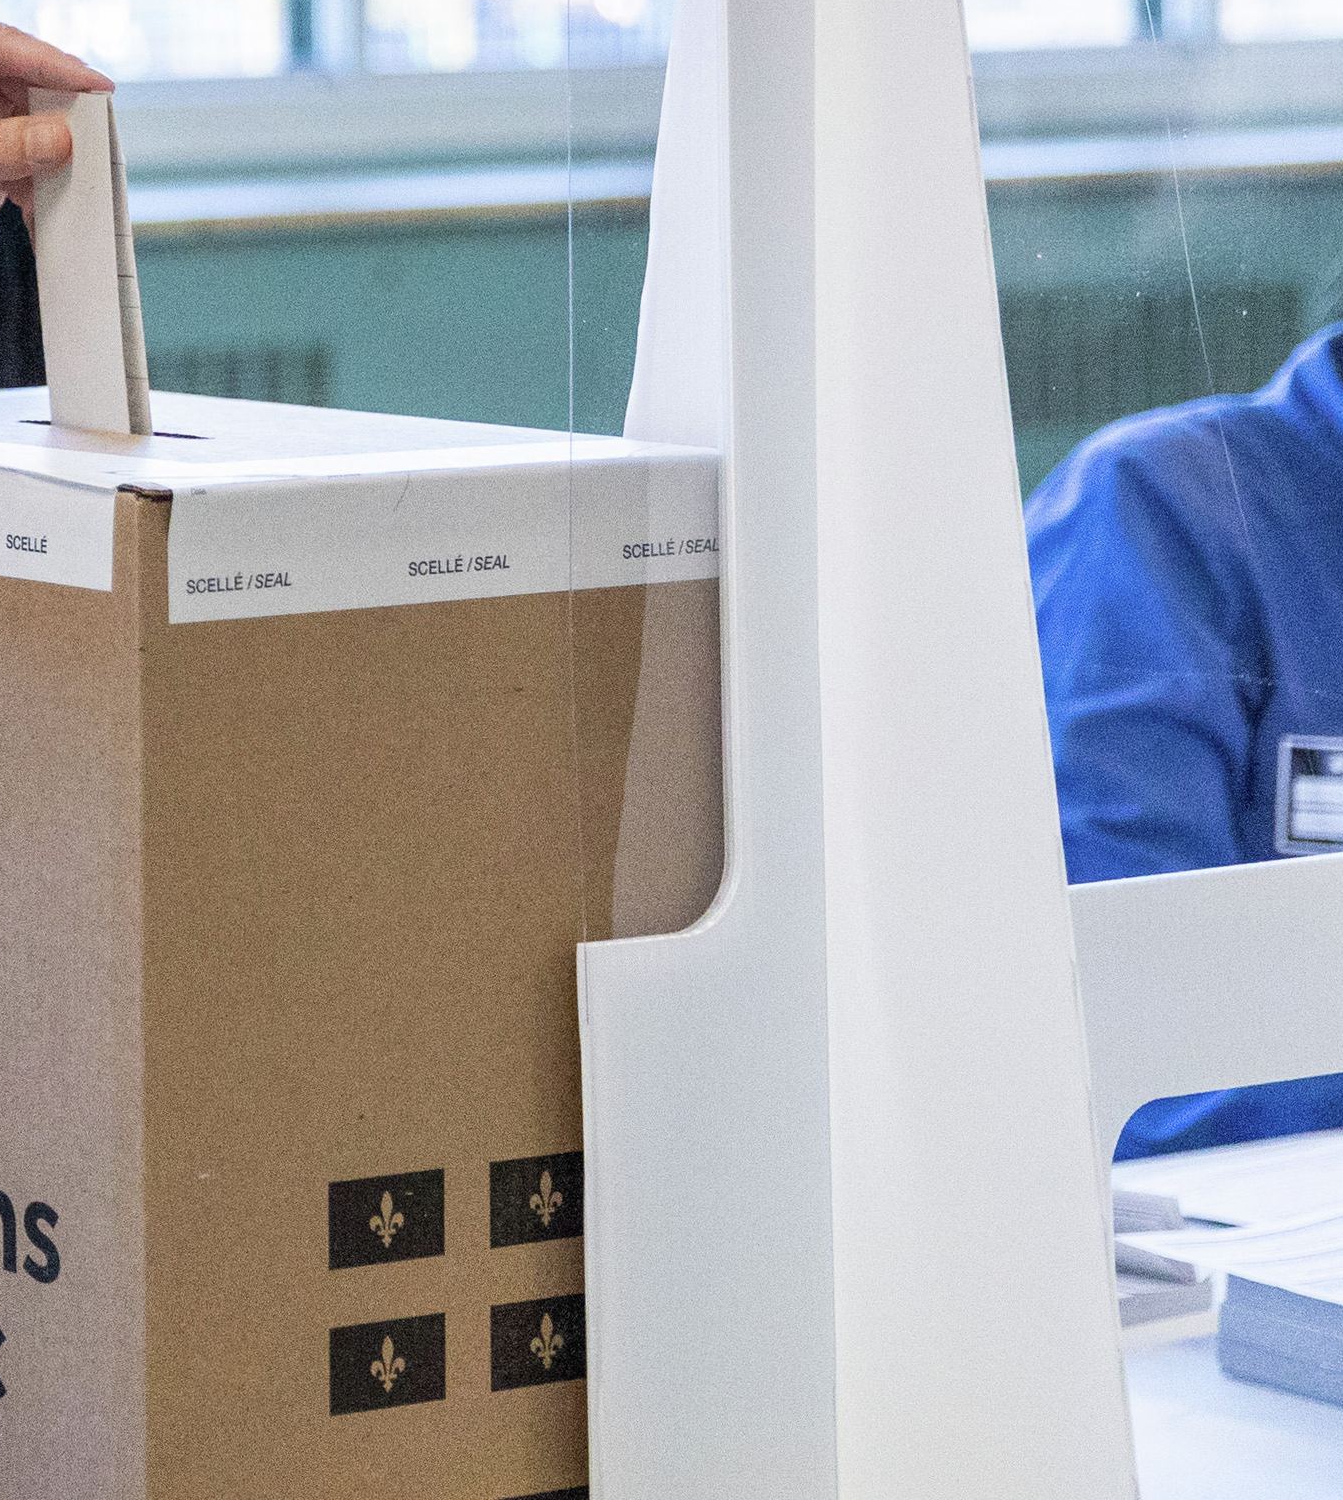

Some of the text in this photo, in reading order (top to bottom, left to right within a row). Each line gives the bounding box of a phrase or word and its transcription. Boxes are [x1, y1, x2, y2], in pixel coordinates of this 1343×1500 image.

[6, 534, 48, 554] SCELLÉ
[622, 538, 675, 560] SCELLÉ
[408, 555, 464, 577] SCELLÉ
[186, 572, 244, 594] SCELLÉ
